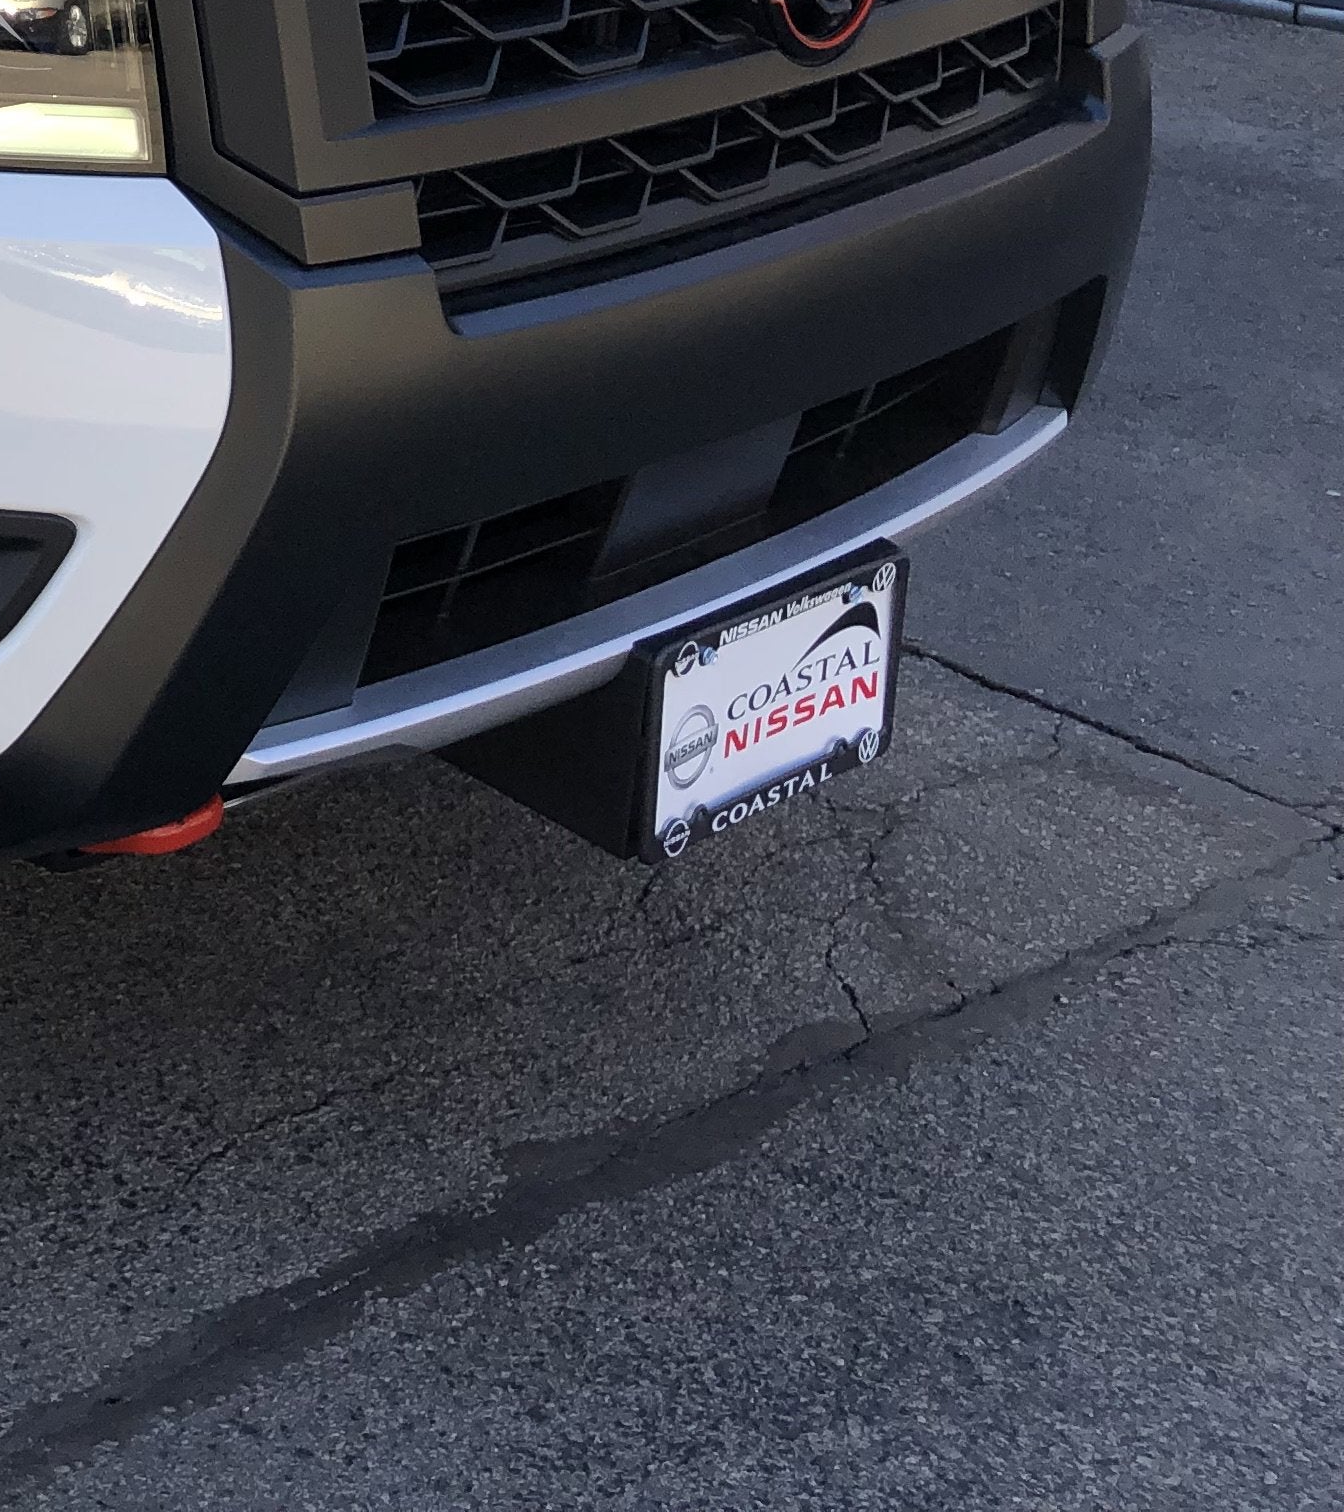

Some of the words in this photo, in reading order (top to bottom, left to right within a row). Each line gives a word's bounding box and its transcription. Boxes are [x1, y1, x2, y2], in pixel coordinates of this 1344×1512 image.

[719, 608, 783, 646] NISSAN
[724, 670, 879, 759] NISSAN
[727, 639, 880, 722] COASTAL
[669, 730, 713, 766] NISSAN
[711, 762, 833, 833] COASTAL
